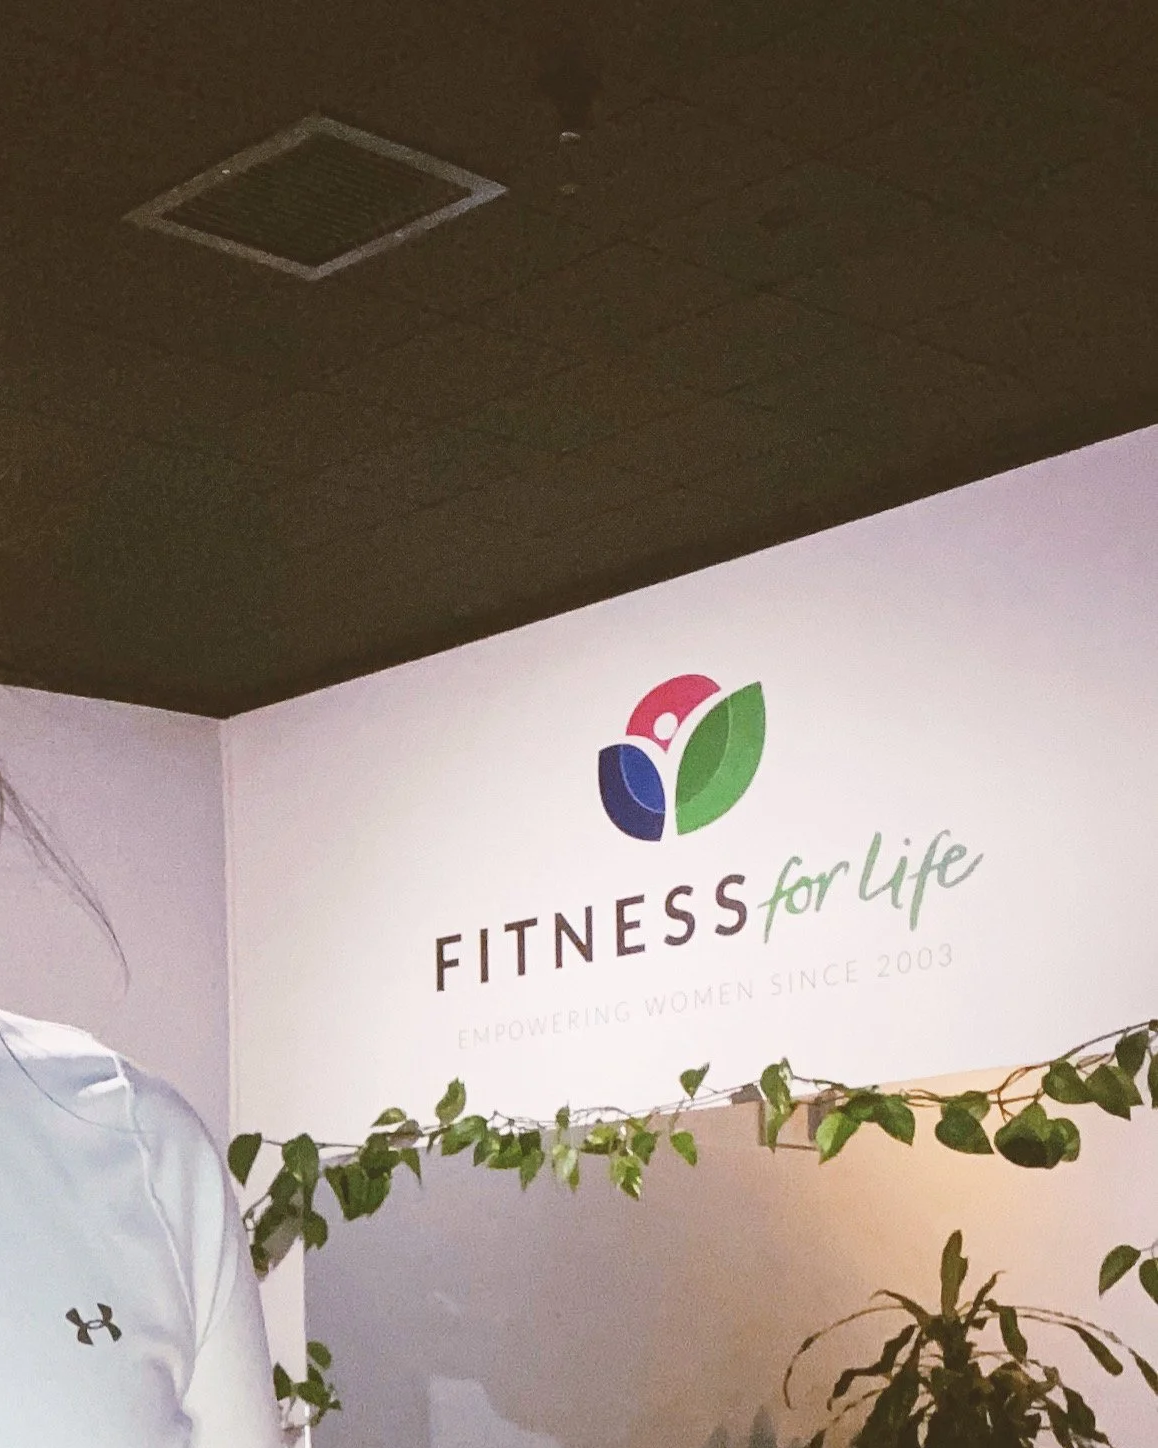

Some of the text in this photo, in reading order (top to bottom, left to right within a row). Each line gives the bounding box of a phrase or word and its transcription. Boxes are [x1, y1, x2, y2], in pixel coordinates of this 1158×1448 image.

[436, 873, 748, 993] FITNESS
[757, 855, 850, 944] for
[457, 942, 953, 1051] EMPOWERING WOMEN SINCE 2003
